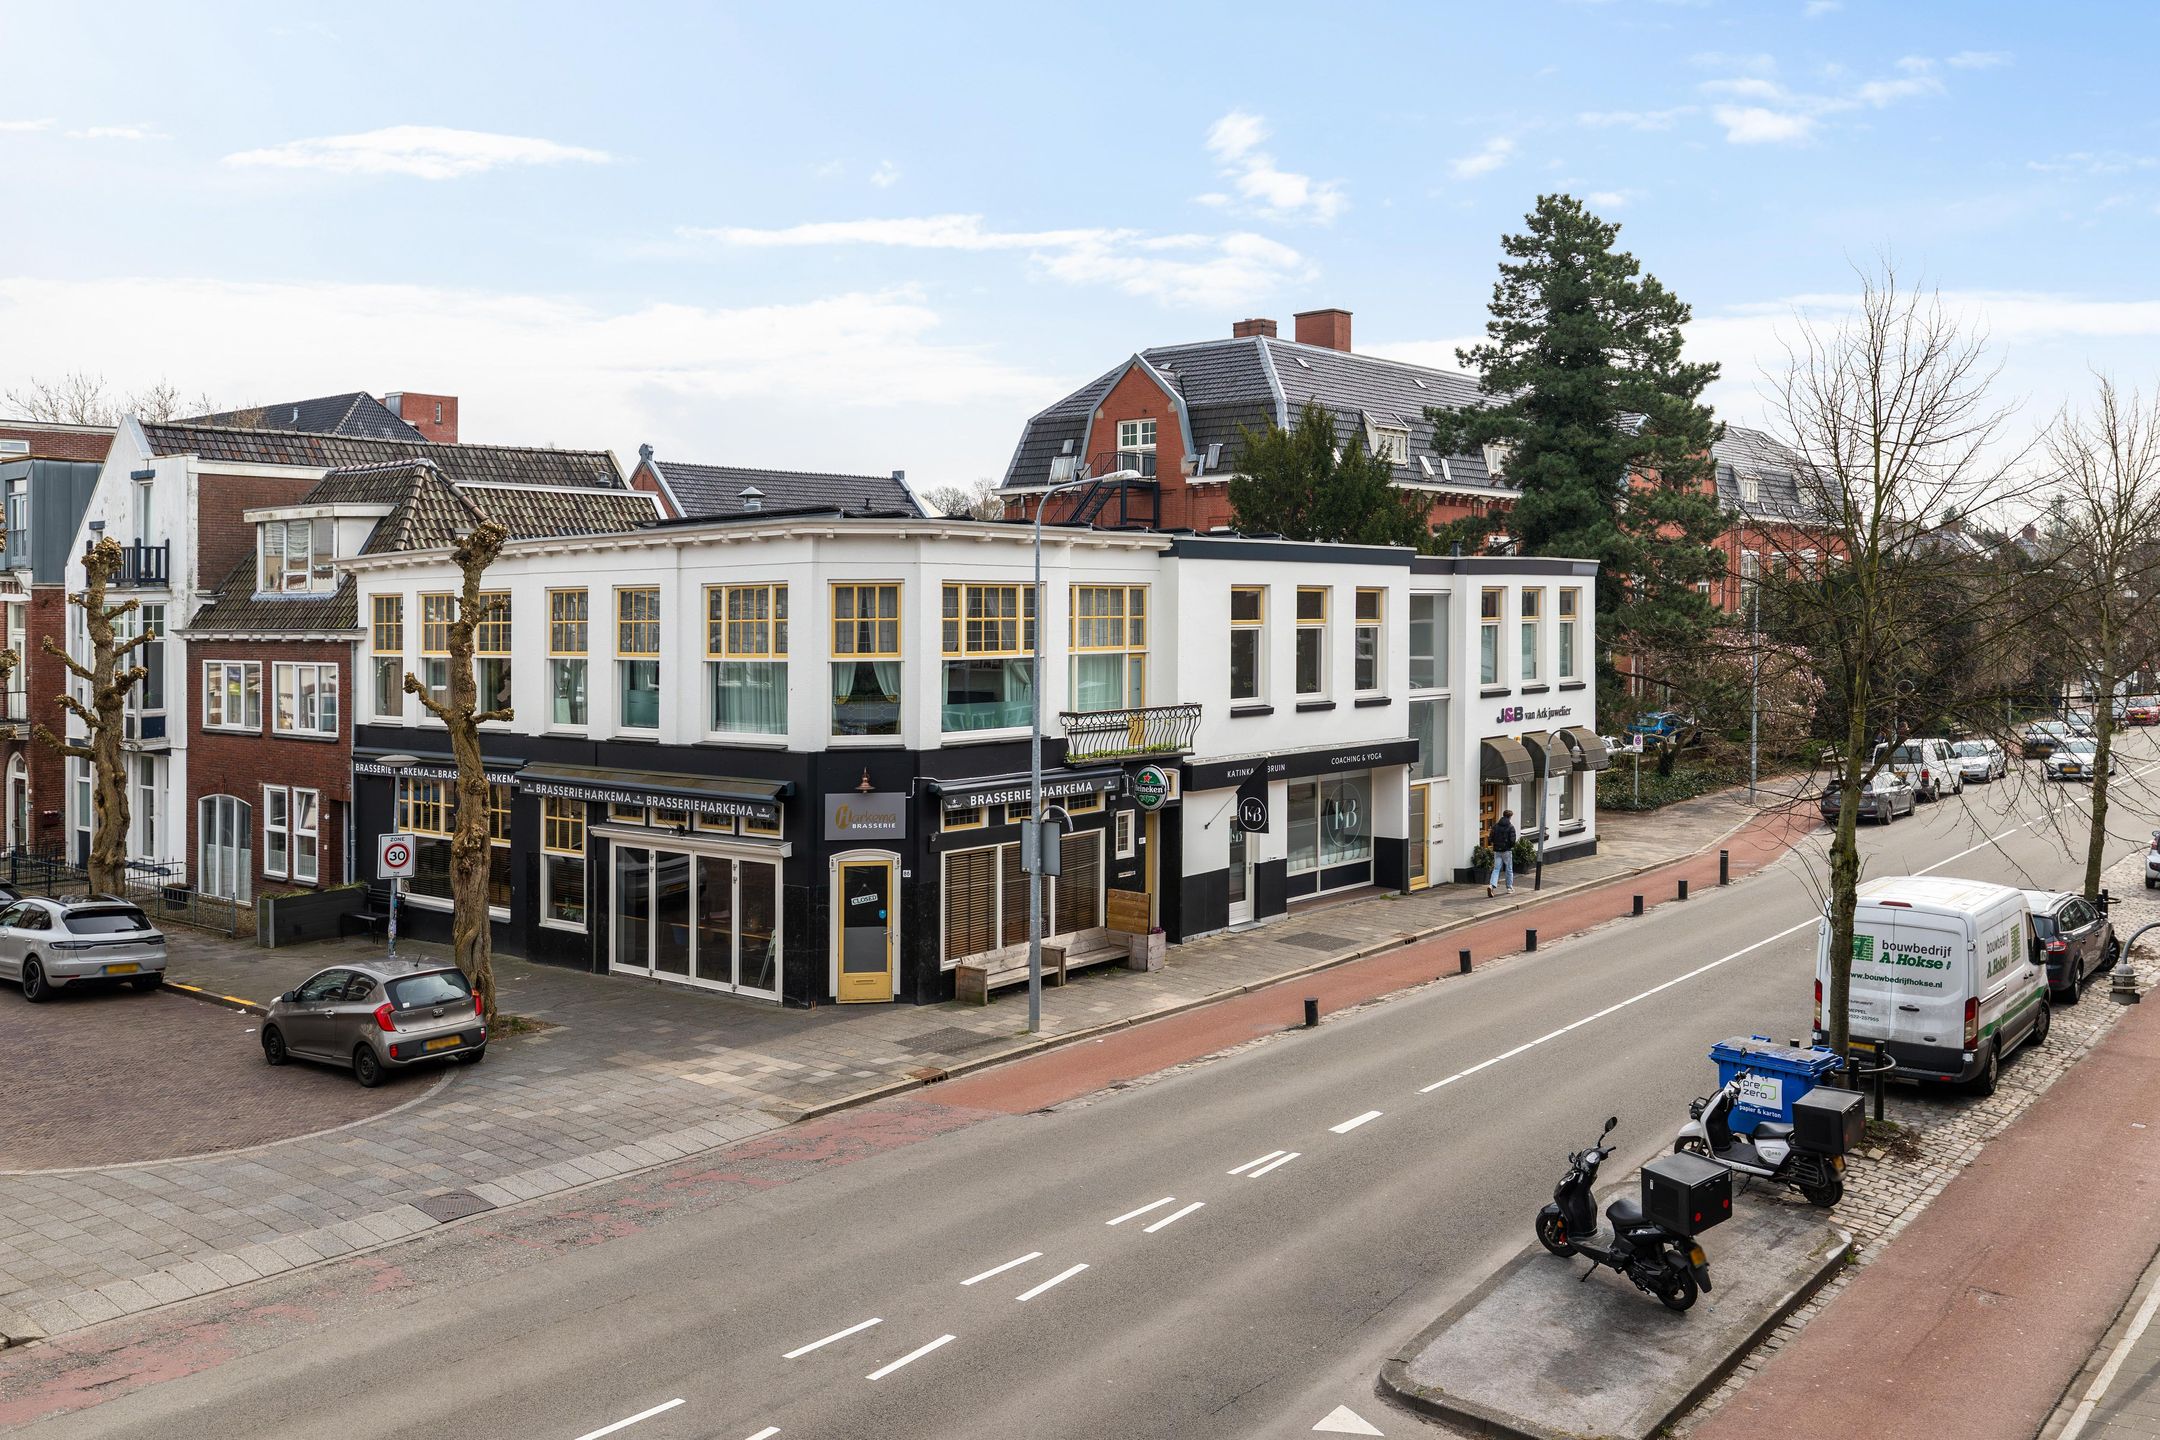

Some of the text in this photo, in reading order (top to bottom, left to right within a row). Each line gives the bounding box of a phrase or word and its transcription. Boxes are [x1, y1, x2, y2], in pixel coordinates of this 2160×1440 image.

[1496, 705, 1571, 723] J&B van Ark juwelier
[1331, 754, 1360, 765] COACHING
[1366, 752, 1382, 760] YOGA
[355, 763, 391, 775] BRASSERIE
[1227, 767, 1255, 778] KATINKA
[535, 783, 754, 816] BRASSERIE HARKEMA BRASSERIE HARKEMA
[970, 781, 1093, 806] BRASSERIE HARKEMA
[389, 850, 406, 861] 30
[852, 894, 877, 905] CLOSED
[1882, 939, 1952, 958] bouwbedrijf
[1742, 1079, 1761, 1090] pre
[1743, 1087, 1768, 1100] zero
[1739, 1104, 1782, 1119] papier & karton
